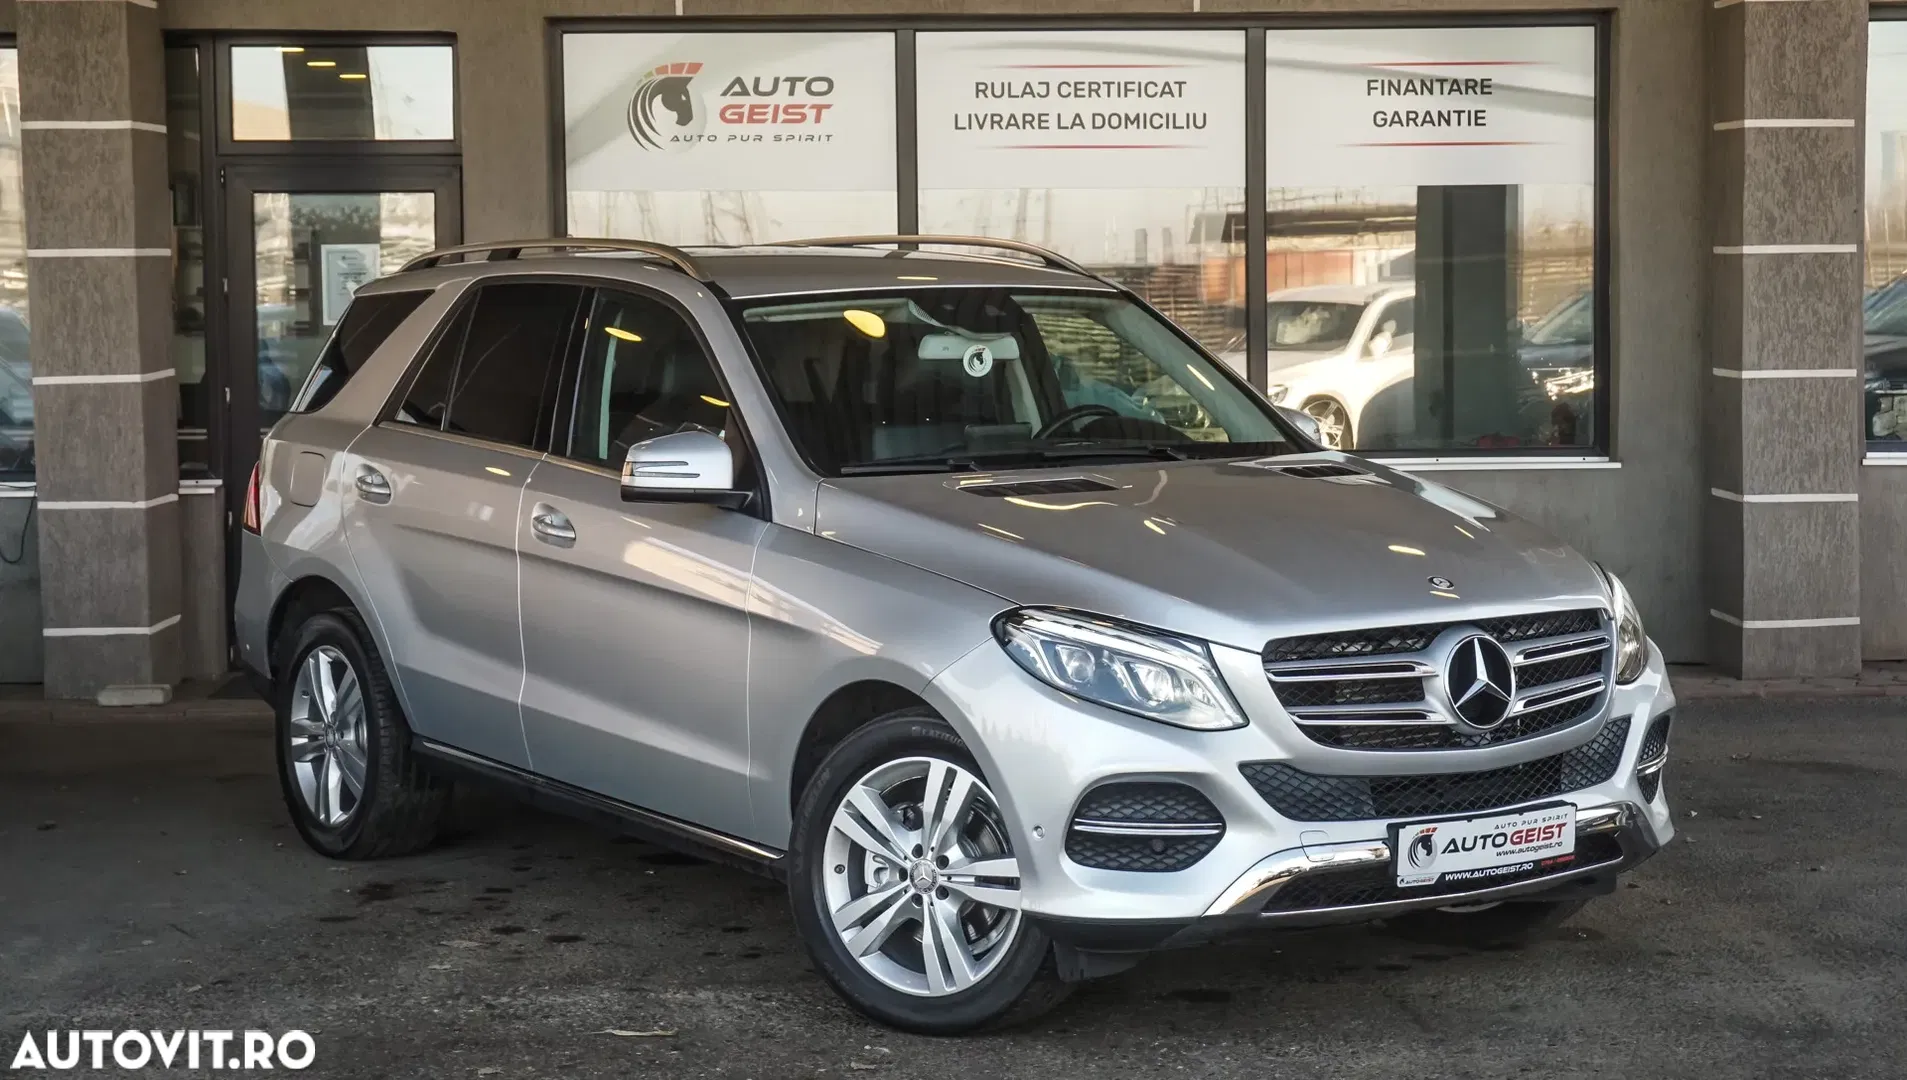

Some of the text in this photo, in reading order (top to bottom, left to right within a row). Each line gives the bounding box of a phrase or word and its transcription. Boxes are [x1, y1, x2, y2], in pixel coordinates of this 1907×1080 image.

[719, 76, 835, 97] AUTO
[975, 81, 1187, 98] RULAJ CERTIFICAT
[1366, 78, 1493, 96] FINANTARE
[718, 103, 834, 124] GEIST
[954, 112, 1208, 130] LIVRARE LA DOMICILIU
[1373, 110, 1487, 127] GARANTIE
[669, 134, 834, 142] AUTO PUR SPIRIT
[1494, 813, 1568, 830] AUTO PUR SPIRIT
[1496, 841, 1563, 857] www.autogeist.ro
[1445, 862, 1534, 880] WWW.AUTOGEIST.RO
